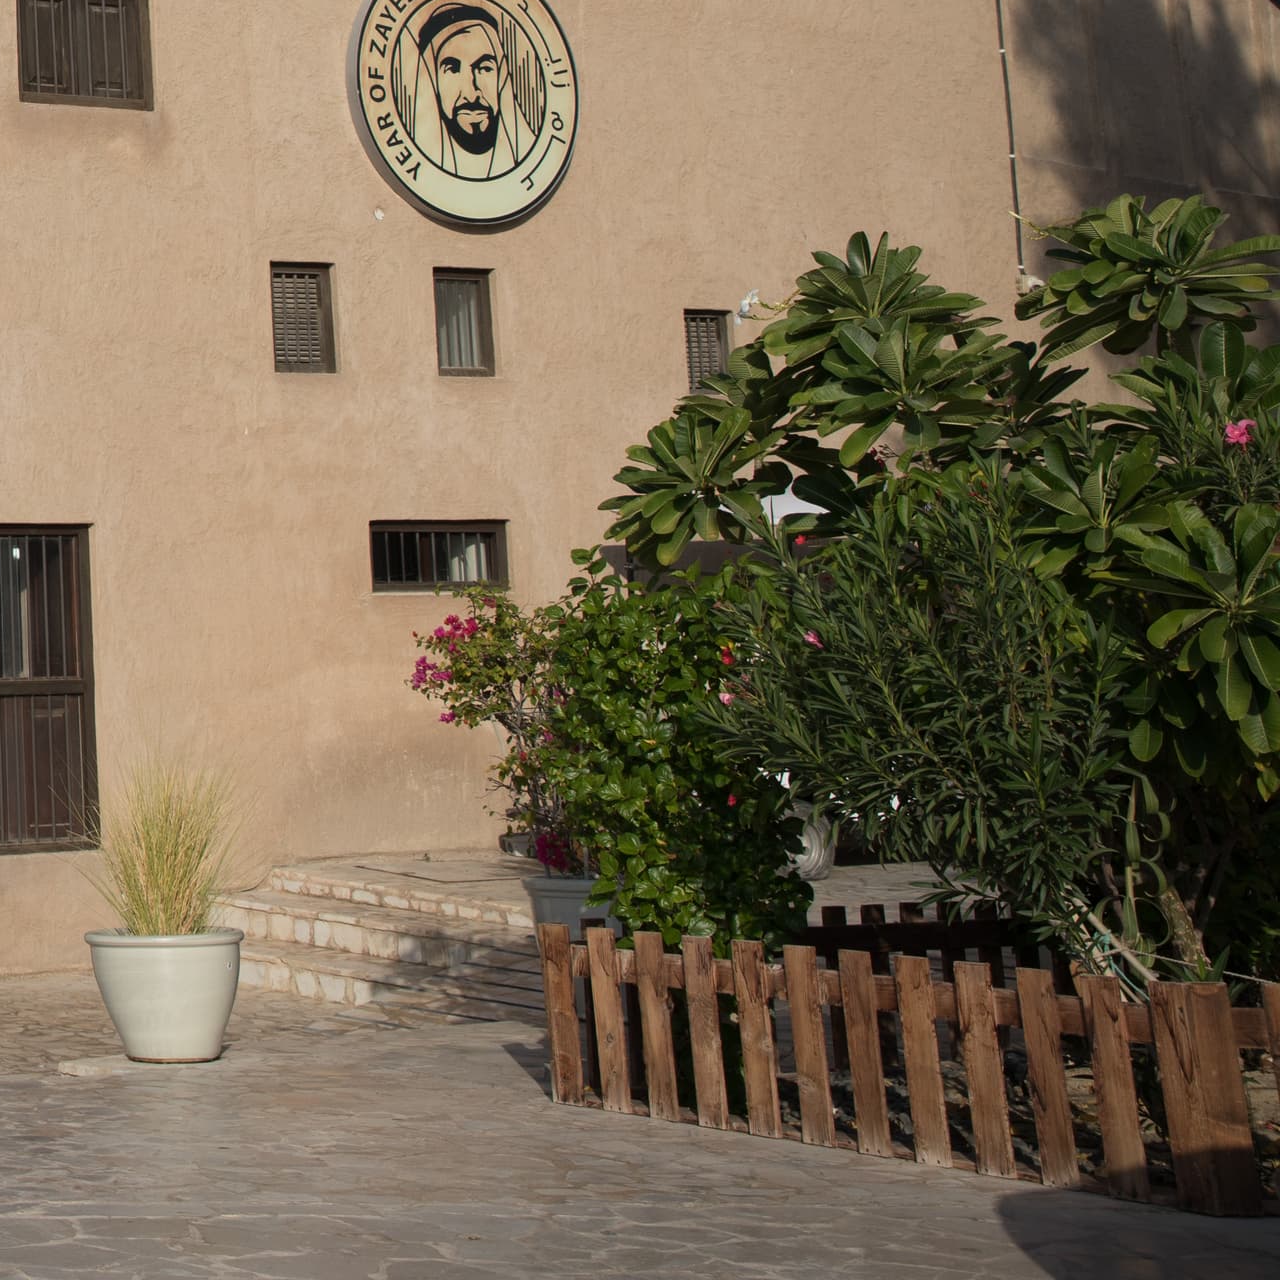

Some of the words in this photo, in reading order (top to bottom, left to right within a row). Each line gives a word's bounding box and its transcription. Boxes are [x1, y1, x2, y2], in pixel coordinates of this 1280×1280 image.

[517, 0, 571, 88] زايد
[367, 66, 387, 103] OF
[376, 111, 422, 181] YEAR
